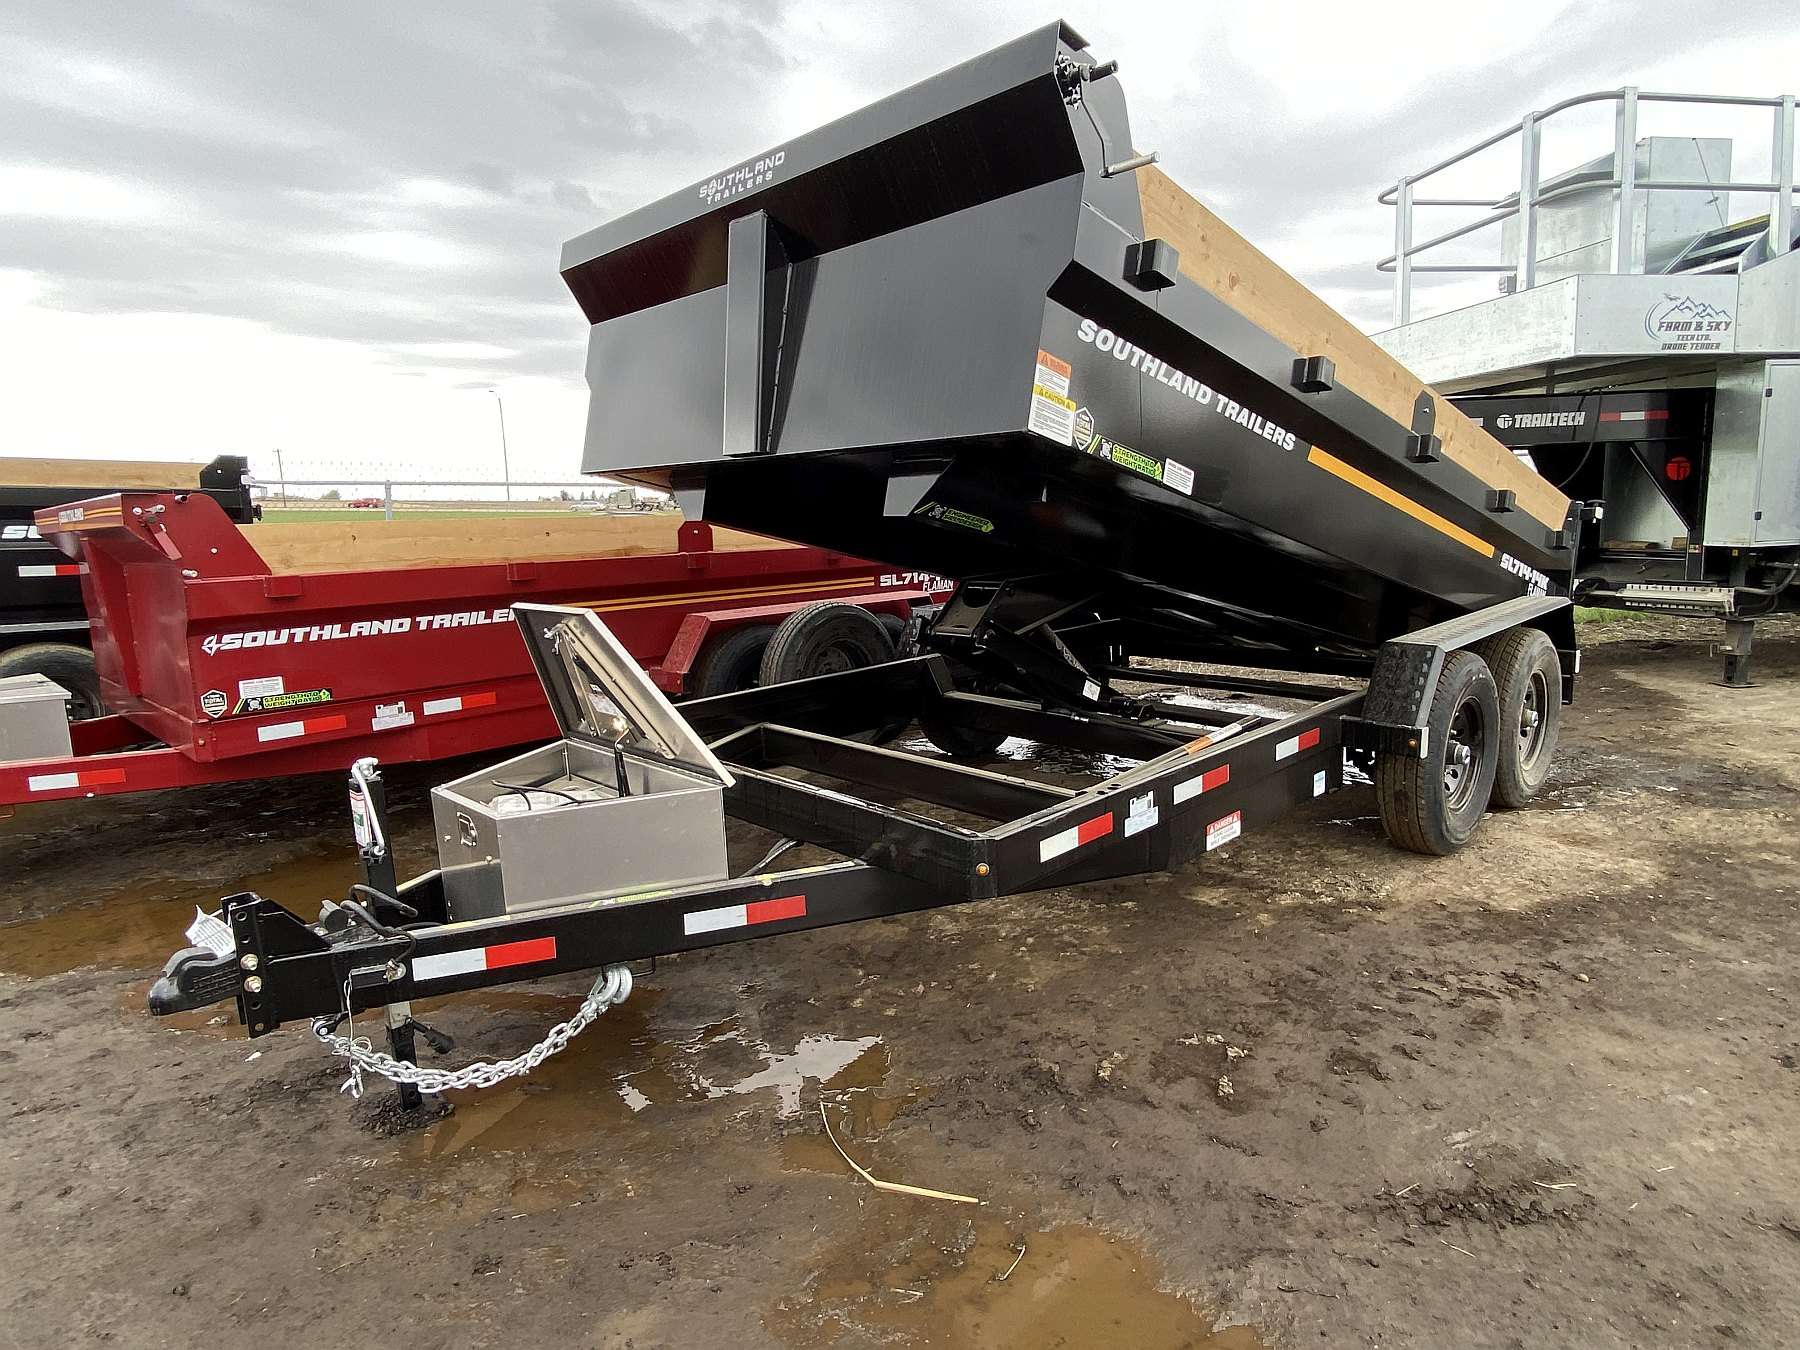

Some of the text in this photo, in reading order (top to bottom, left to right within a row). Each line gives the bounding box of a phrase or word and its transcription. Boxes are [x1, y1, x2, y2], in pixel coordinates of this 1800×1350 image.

[699, 151, 785, 198] SOUTHLAND
[707, 171, 773, 205] TRAILERS
[1658, 321, 1732, 331] FARM & SKY
[1690, 342, 1721, 350] TENDER
[1077, 318, 1296, 451] SOUTHLAND TRAILERS
[1514, 411, 1585, 428] TRAILTECH
[923, 580, 953, 593] FLAMAN
[220, 617, 411, 650] SOUTHLAND
